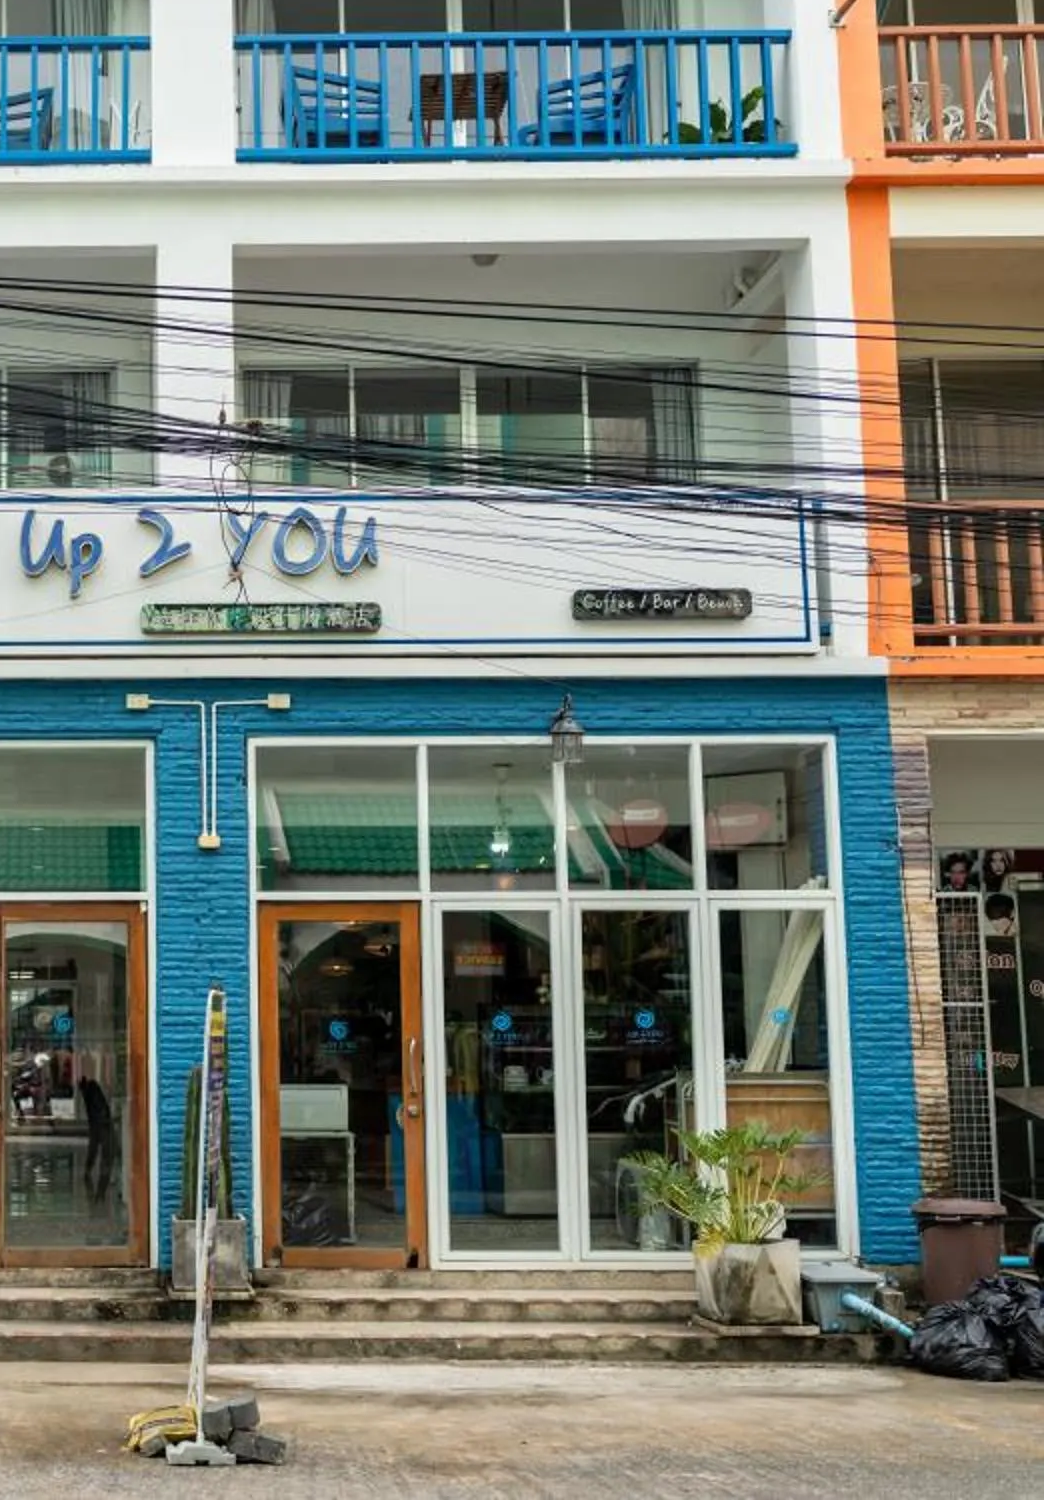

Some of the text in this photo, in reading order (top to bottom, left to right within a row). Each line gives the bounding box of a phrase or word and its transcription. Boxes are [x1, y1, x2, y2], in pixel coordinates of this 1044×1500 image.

[136, 508, 193, 579] 2
[582, 592, 635, 614] Coffee
[652, 594, 680, 610] Bar
